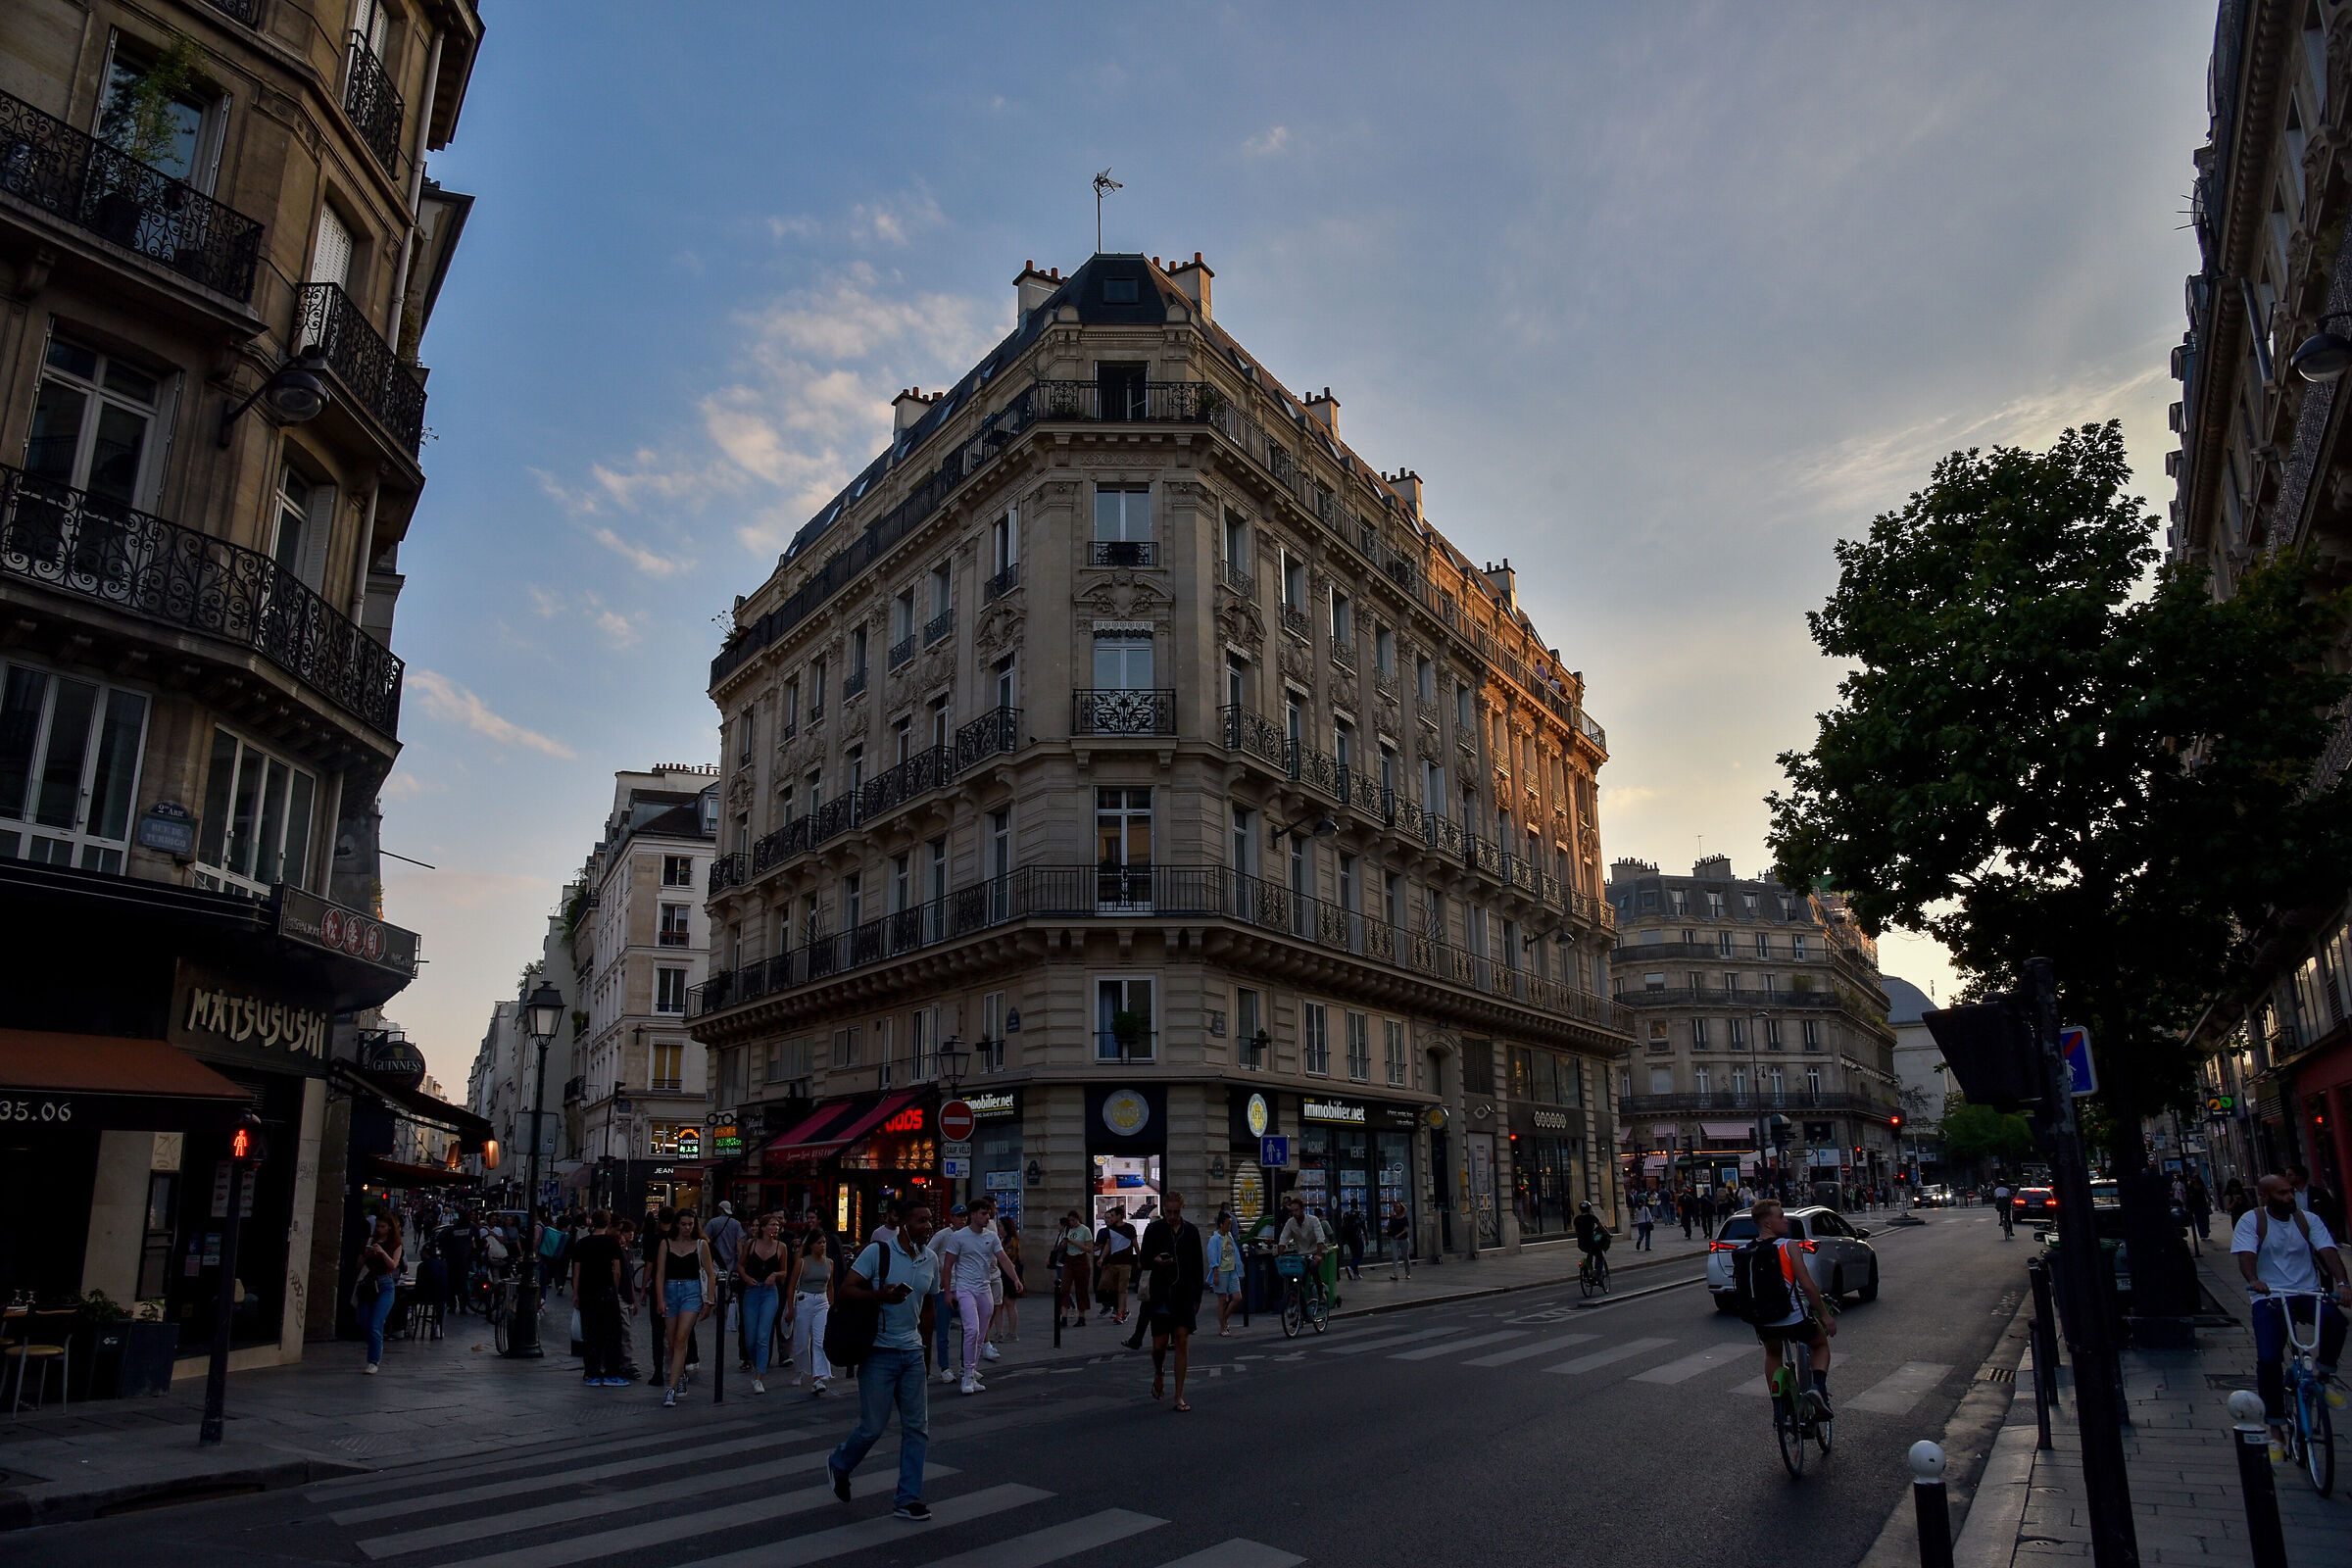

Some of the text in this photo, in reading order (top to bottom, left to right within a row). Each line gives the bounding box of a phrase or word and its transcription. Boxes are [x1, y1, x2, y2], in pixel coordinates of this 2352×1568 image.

[372, 1059, 422, 1074] GUINNESS
[0, 1100, 72, 1121] 35.06
[1303, 1100, 1365, 1121] immobilier.net
